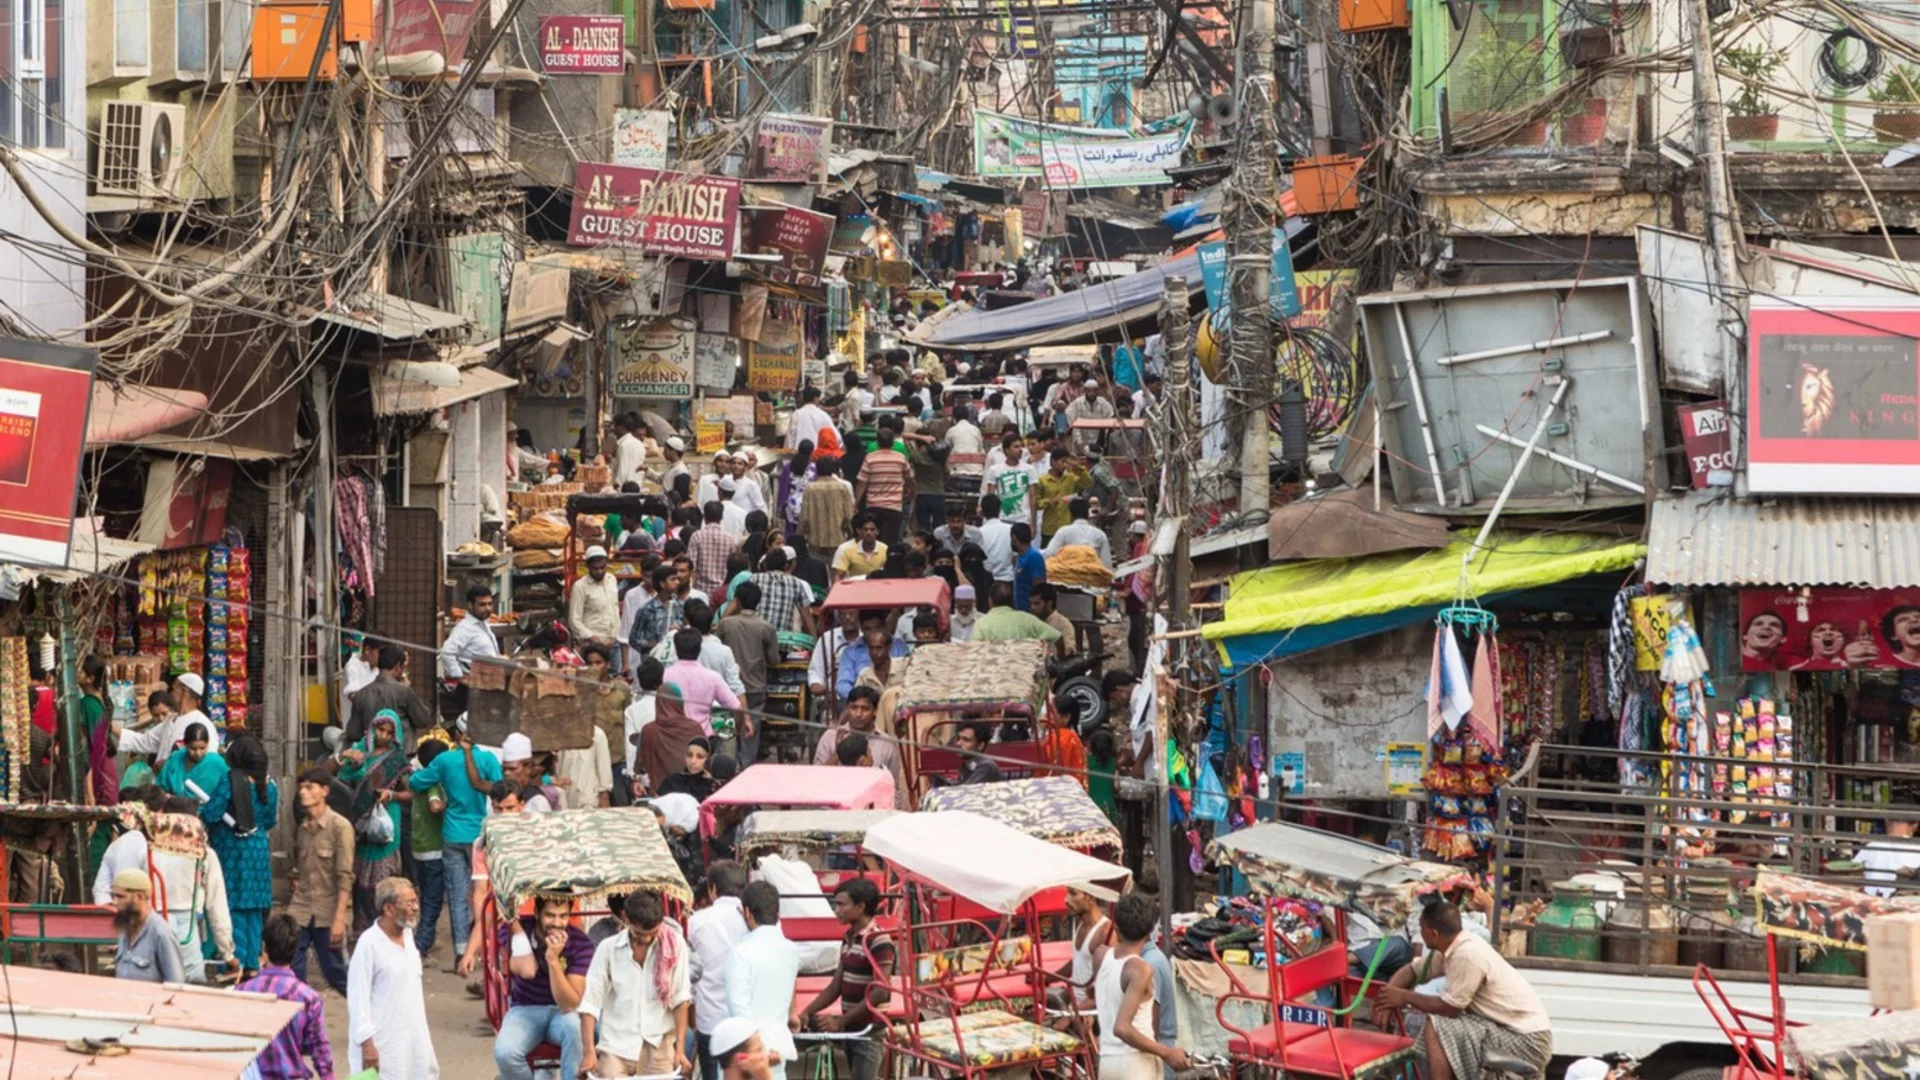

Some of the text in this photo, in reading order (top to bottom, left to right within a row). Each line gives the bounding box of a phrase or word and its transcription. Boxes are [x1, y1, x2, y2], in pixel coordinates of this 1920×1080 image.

[545, 26, 562, 50] AL
[573, 27, 619, 51] DANISH
[545, 53, 620, 67] GUEST HOUSE
[584, 174, 614, 210] AL
[635, 178, 728, 223] DANISH
[581, 215, 649, 239] GUEST
[654, 222, 724, 246] HOUSE
[617, 371, 688, 383] CURRENCY
[616, 384, 688, 395] EXCHANGER
